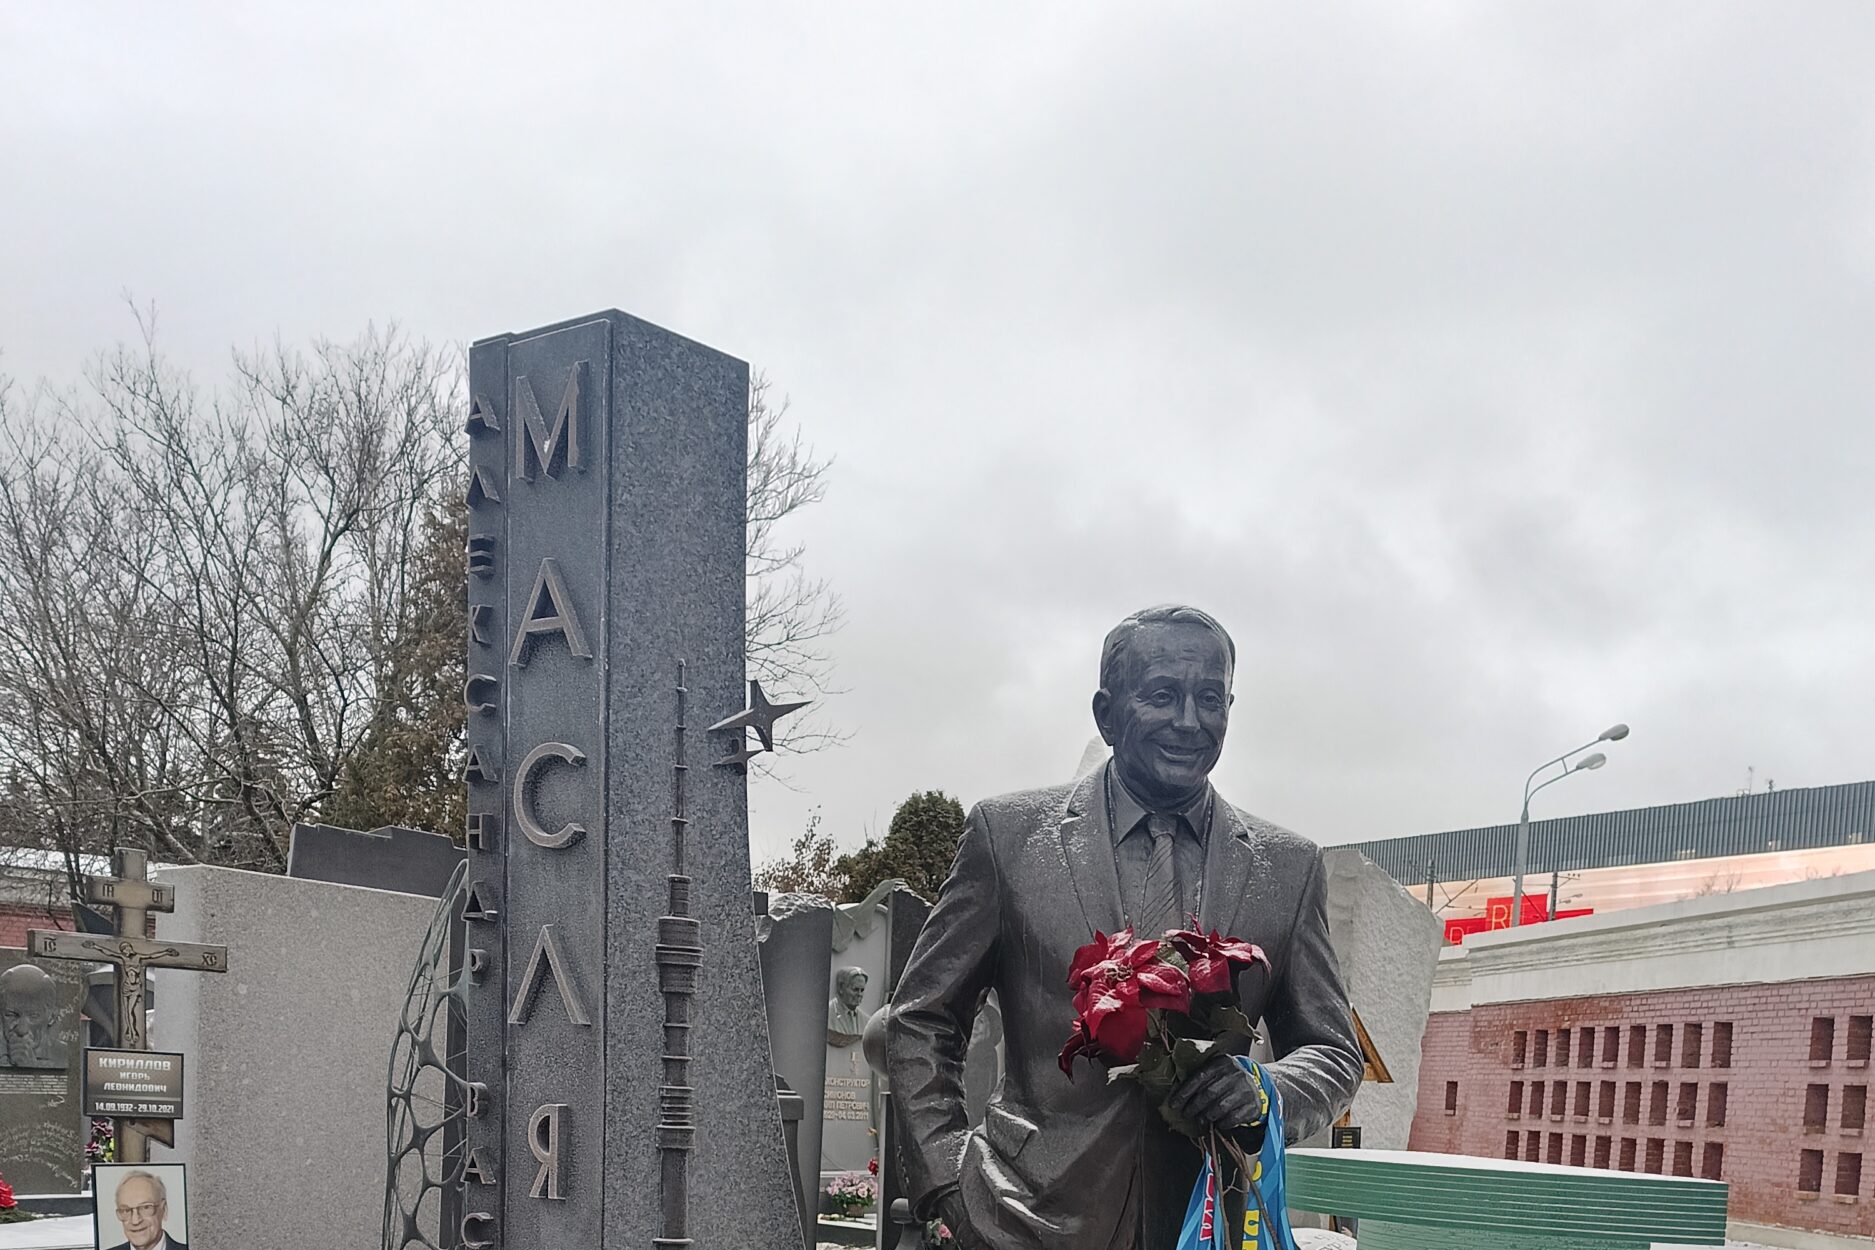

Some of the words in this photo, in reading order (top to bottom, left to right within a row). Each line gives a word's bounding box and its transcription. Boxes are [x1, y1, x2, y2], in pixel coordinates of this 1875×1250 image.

[99, 1057, 171, 1071] КИРИЛЛОВ
[119, 1071, 151, 1081] ИГОРЬ
[103, 1082, 167, 1093] ЛЕОНИДОВИЧ
